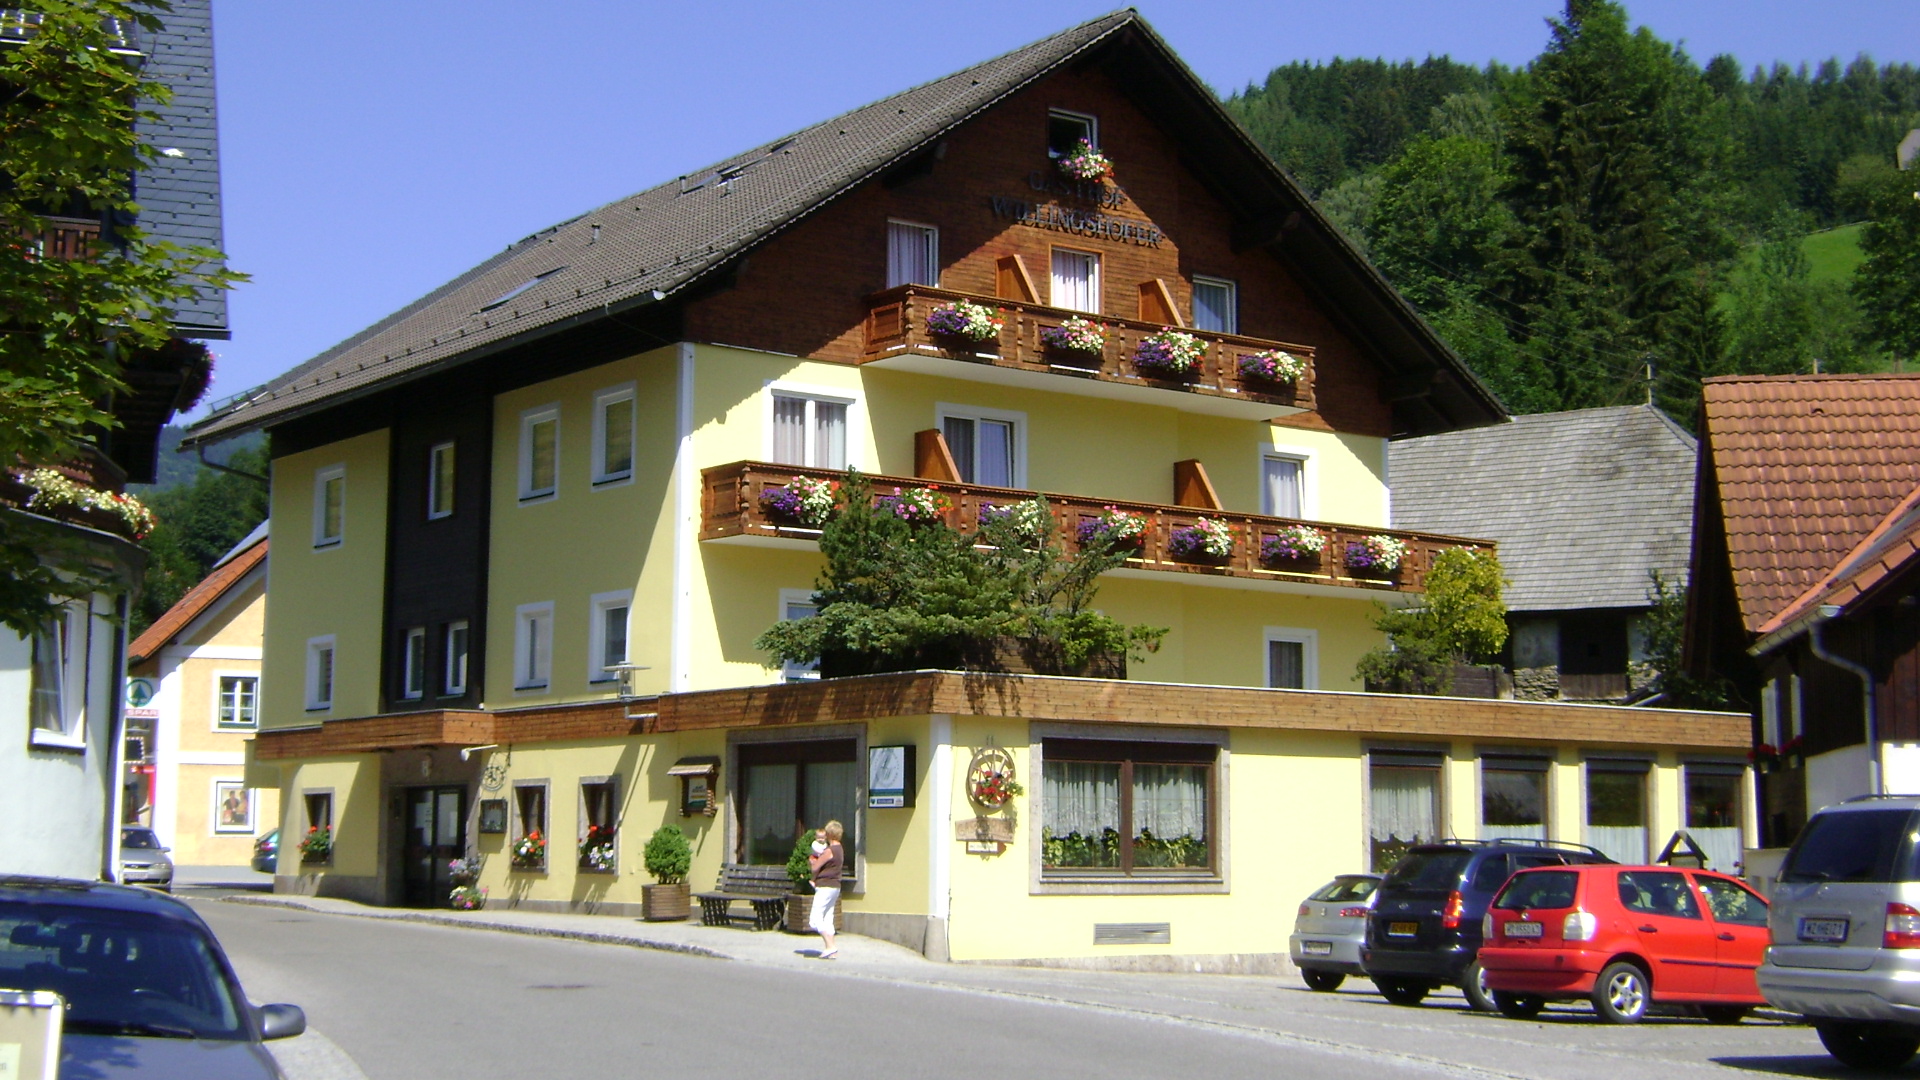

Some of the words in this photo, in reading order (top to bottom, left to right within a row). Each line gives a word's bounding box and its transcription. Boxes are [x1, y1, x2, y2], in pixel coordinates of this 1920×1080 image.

[1028, 170, 1126, 206] GASTHOF
[991, 195, 1163, 244] WILLINGSHOFER
[127, 708, 158, 717] SPAR
